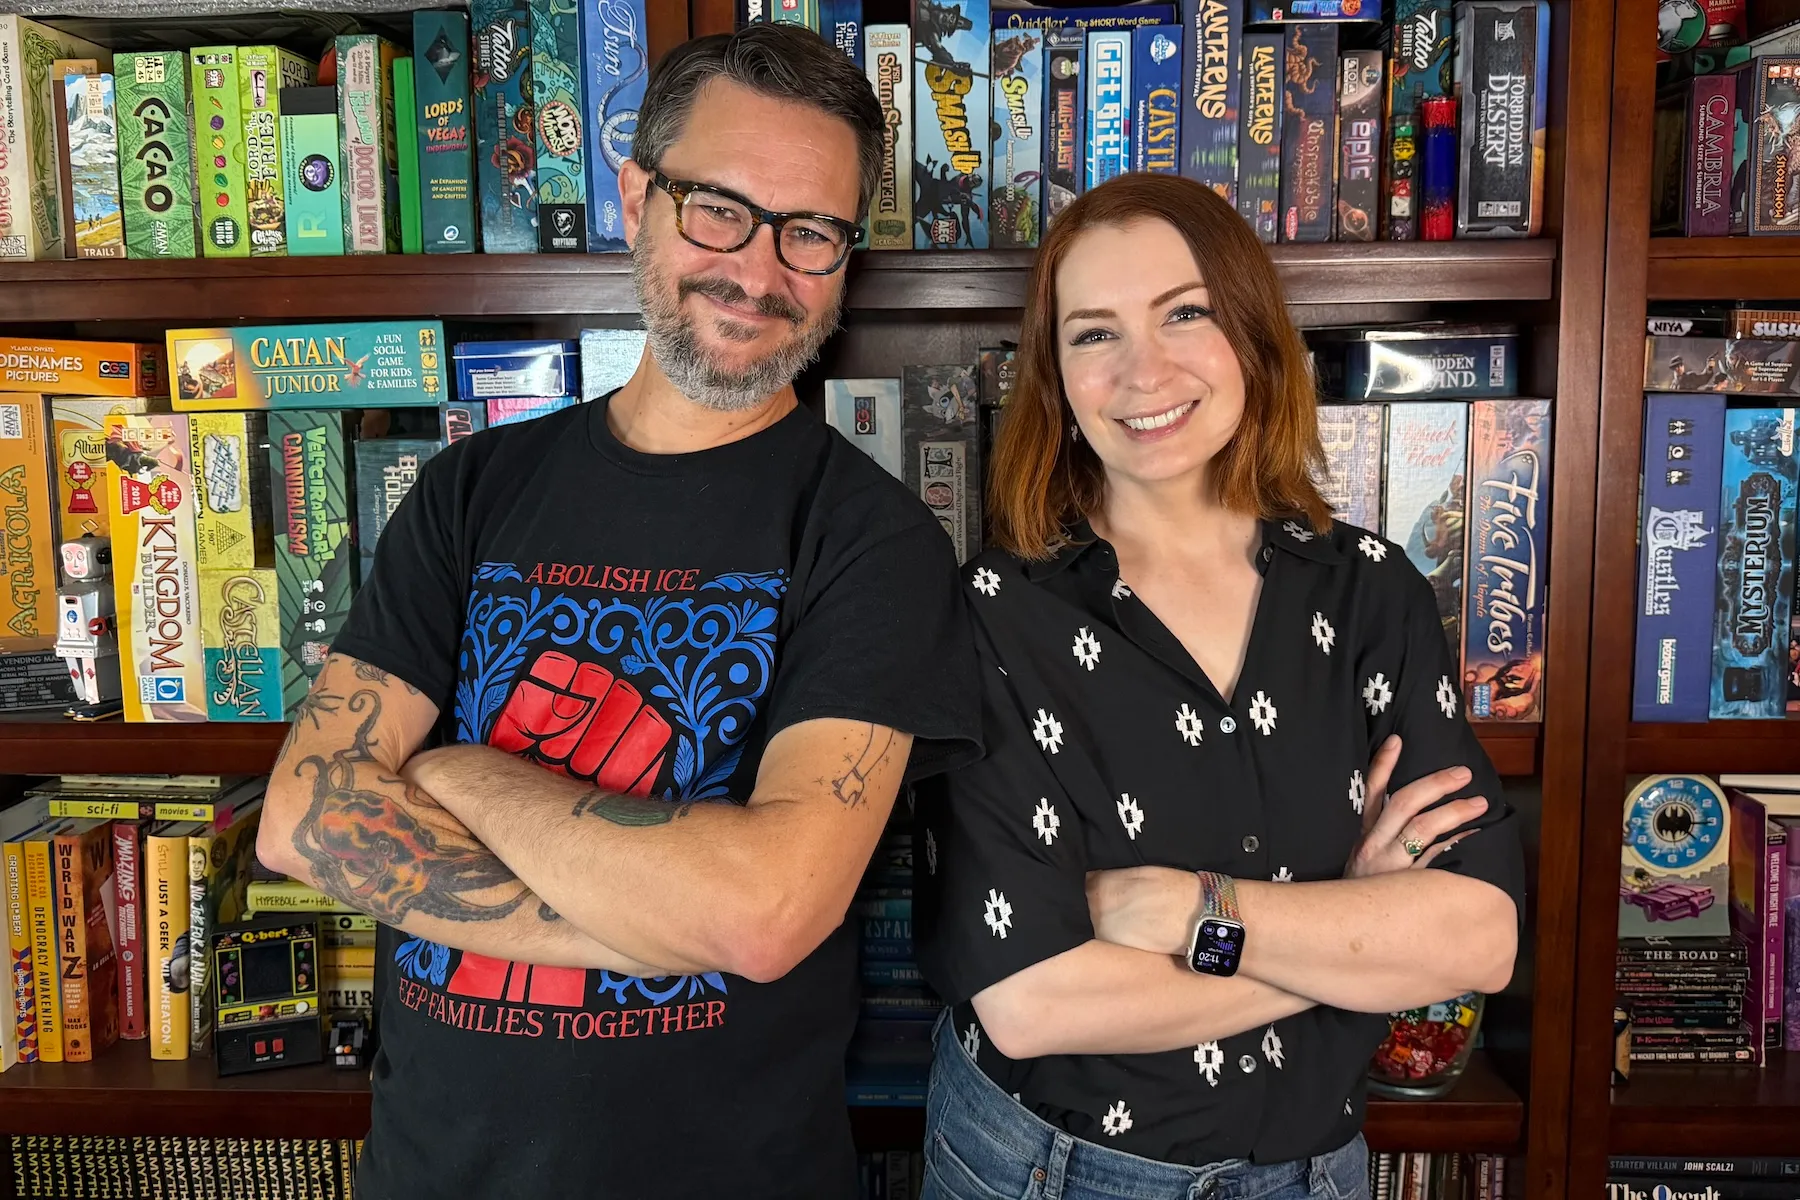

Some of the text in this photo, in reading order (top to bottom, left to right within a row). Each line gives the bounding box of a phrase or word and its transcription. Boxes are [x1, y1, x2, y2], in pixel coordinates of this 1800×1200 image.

[1007, 13, 1161, 33] Quiddler The SHORT Word Game
[1291, 1, 1341, 14] STAR TREK
[479, 34, 490, 68] STORIES
[489, 19, 515, 82] Tattoo
[597, 0, 636, 77] Tsuro
[845, 21, 859, 58] Ghost
[1402, 24, 1413, 57] STORIES
[1413, 9, 1437, 70] Tattoo
[3, 65, 11, 84] Card
[281, 57, 310, 80] LORD
[363, 61, 372, 85] Players
[891, 65, 903, 83] USA
[1096, 43, 1121, 96] Get
[1192, 63, 1202, 98] FESTIVAL
[424, 98, 464, 120] LORD$
[1249, 46, 1275, 145] LANTERNS
[349, 91, 375, 145] ISLAND
[427, 124, 466, 142] VEGA$
[437, 116, 450, 127] OF
[554, 104, 579, 148] WORD
[924, 63, 982, 175] SMASH UP
[1484, 72, 1512, 170] DESERT
[1508, 75, 1527, 166] FORBIDDEN
[133, 97, 173, 213] CACAO
[258, 111, 277, 181] FRIES
[1702, 94, 1729, 217] CAMBRIA
[354, 145, 380, 247] DOCTOR LUCKY
[1694, 169, 1703, 209] SURRENDER
[1773, 154, 1788, 219] MONSTROUS
[216, 221, 225, 245] POINT
[225, 220, 235, 245] SALAD
[936, 218, 952, 243] AEG
[84, 247, 115, 257] TRAILS
[375, 333, 402, 344] A FUN
[1653, 321, 1684, 332] NIYA
[250, 336, 346, 369] CATAN
[373, 345, 406, 356] SOCIAL
[377, 356, 404, 367] GAME
[6, 371, 59, 382] PICTURES
[264, 373, 342, 400] JUNIOR
[367, 378, 418, 389] & FAMILIES
[370, 367, 412, 378] FOR KIDS
[130, 485, 140, 506] 2012
[190, 418, 201, 458] STEVE
[197, 522, 207, 565] GAMES
[283, 432, 309, 557] CANNIBALISM!
[306, 426, 336, 562] VELOCIRAPTOR!
[1, 465, 41, 638] AGRICOLA
[208, 529, 217, 546] 1907
[1479, 450, 1540, 657] Five Tribes
[1736, 494, 1773, 637] MYSTERIUM
[182, 561, 190, 586] DONALD
[525, 562, 701, 593] ABOLISH ICE
[141, 552, 157, 633] BUILDER
[141, 516, 185, 673] KINGDOM
[304, 621, 311, 632] 8+
[4, 656, 42, 665] VENDING
[222, 575, 268, 719] CASTELLAN
[141, 676, 149, 702] GAMES
[148, 676, 156, 702] QUEEN
[1667, 779, 1684, 789] 12
[1691, 785, 1700, 794] 1
[86, 803, 120, 815] sci-fi
[159, 807, 189, 815] movies
[1702, 799, 1713, 808] 2
[1631, 817, 1643, 826] 9
[1707, 816, 1718, 826] 3
[1637, 835, 1648, 844] 8
[1650, 849, 1661, 859] 7
[1686, 848, 1697, 858] 5
[1700, 834, 1711, 844] 4
[115, 834, 136, 902] AMAZING
[1667, 854, 1678, 863] 6
[1770, 851, 1780, 884] WELCOME
[59, 844, 73, 909] WORLD
[157, 843, 170, 951] STILL JUST A GEEK
[62, 915, 76, 953] WAR
[124, 903, 136, 941] QUANTUM
[189, 885, 207, 988] NO FOR MAN
[34, 906, 54, 1033] DEMOCRACY AWAKENING
[62, 956, 84, 979] Z
[1198, 951, 1220, 964] 11:20
[1643, 950, 1719, 960] THE ROAD
[17, 968, 26, 999] WARREN
[160, 956, 172, 1044] WIL WHEATON
[399, 976, 727, 1040] EEP FAMILIES TOGETHER
[13, 1153, 26, 1197] MYTH
[28, 1153, 42, 1197] MYTH
[41, 1153, 54, 1197] MYTH
[55, 1153, 69, 1197] MYTH
[1610, 1161, 1734, 1172] STARTER VILLAIN JOHN SCALZI
[1605, 1183, 1721, 1200] The Occult
